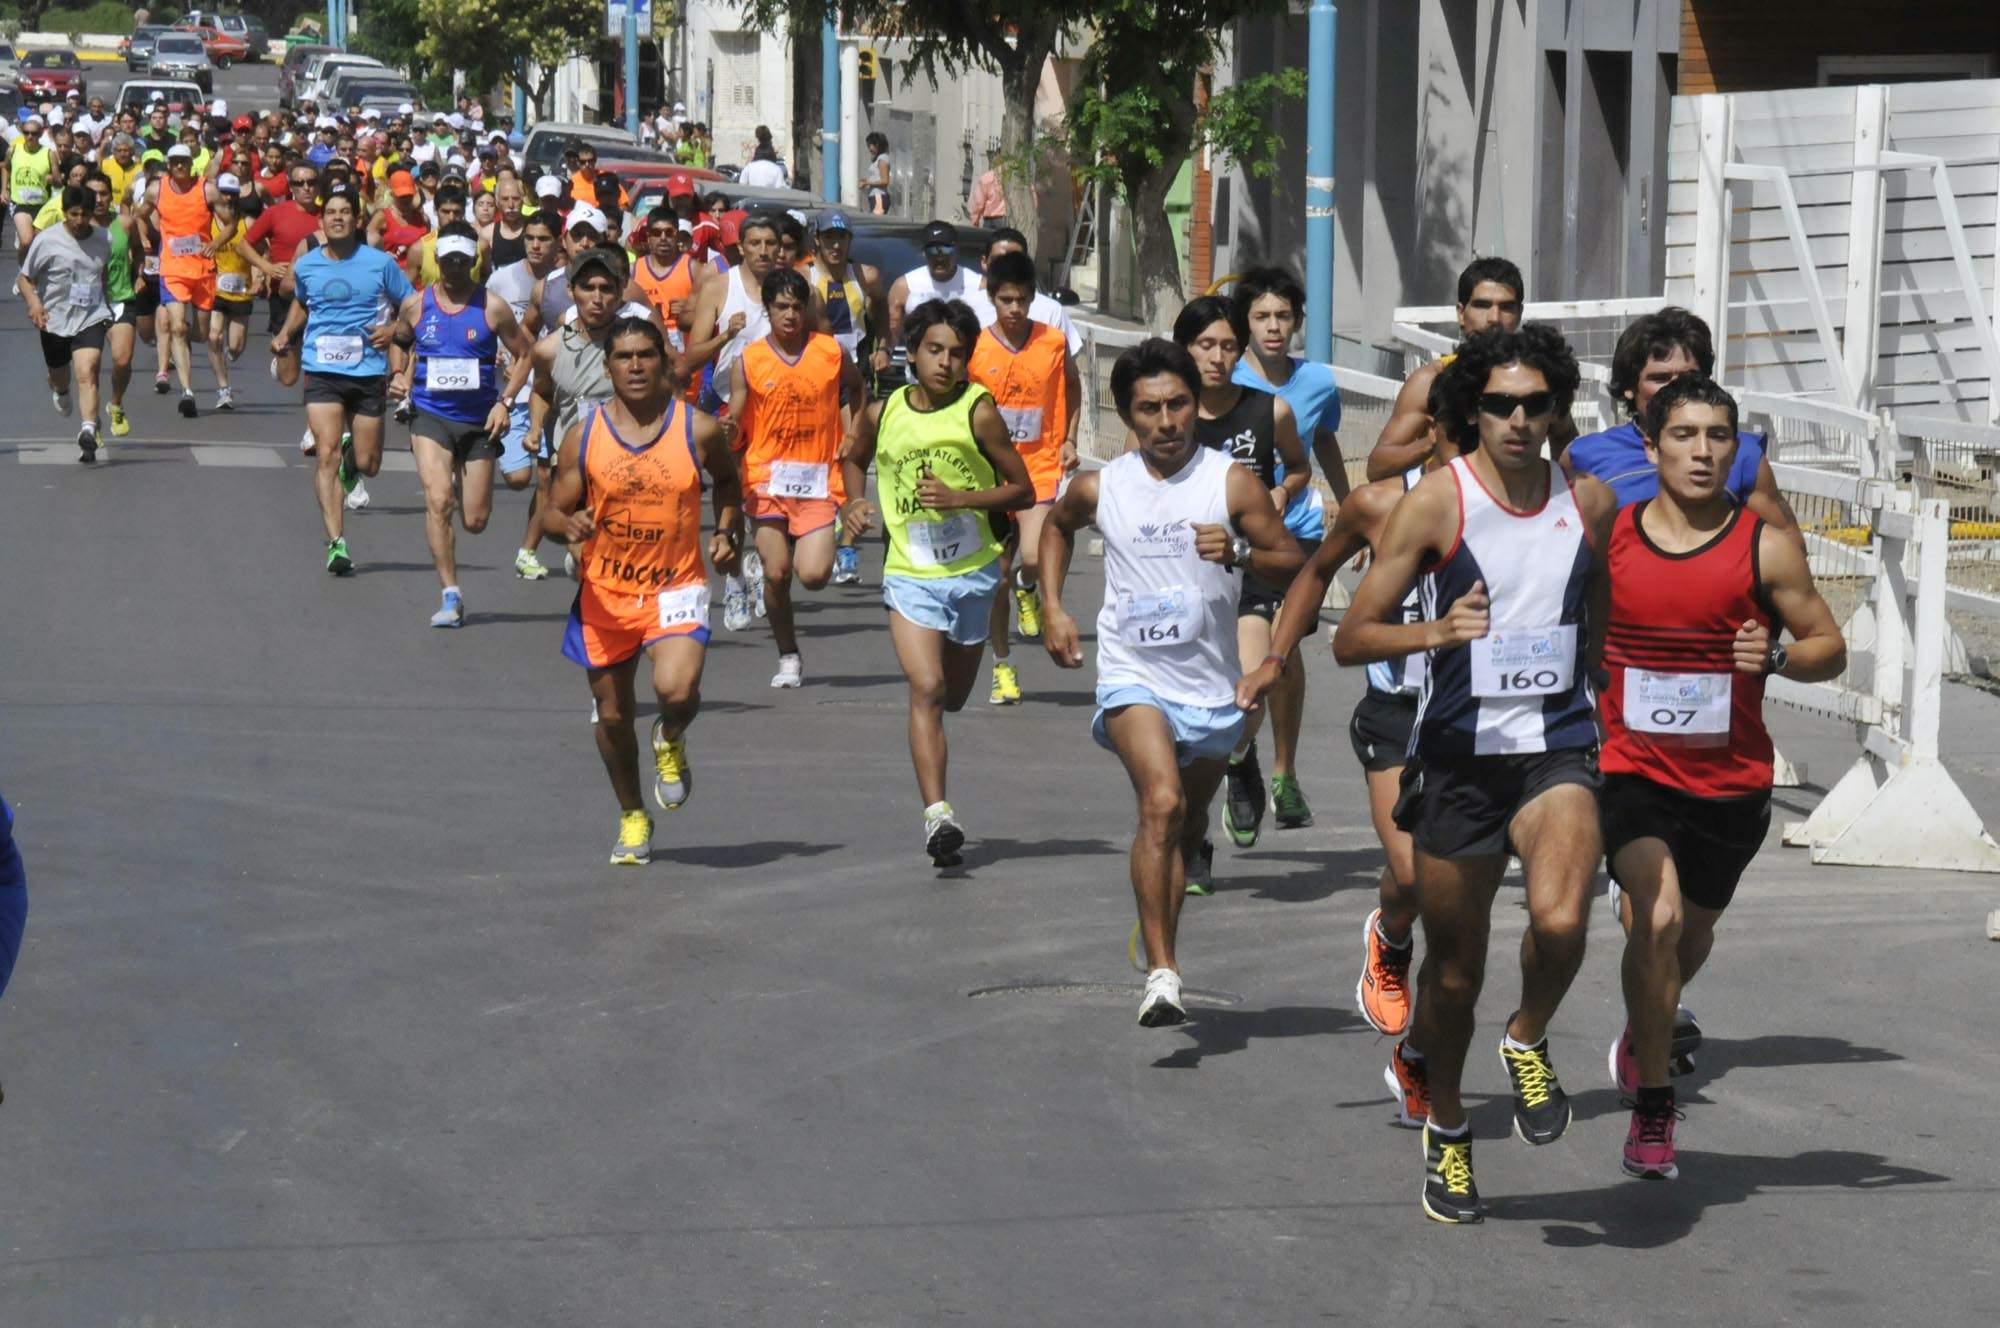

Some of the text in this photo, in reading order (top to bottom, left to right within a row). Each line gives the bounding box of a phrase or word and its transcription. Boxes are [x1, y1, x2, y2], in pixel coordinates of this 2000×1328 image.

[324, 351, 353, 361] 067
[436, 375, 469, 385] 099
[784, 484, 813, 494] 192
[933, 542, 960, 560] 117
[666, 609, 696, 624] 191
[1138, 623, 1180, 642] 164
[1499, 668, 1559, 691] 160
[1650, 708, 1698, 727] 07
